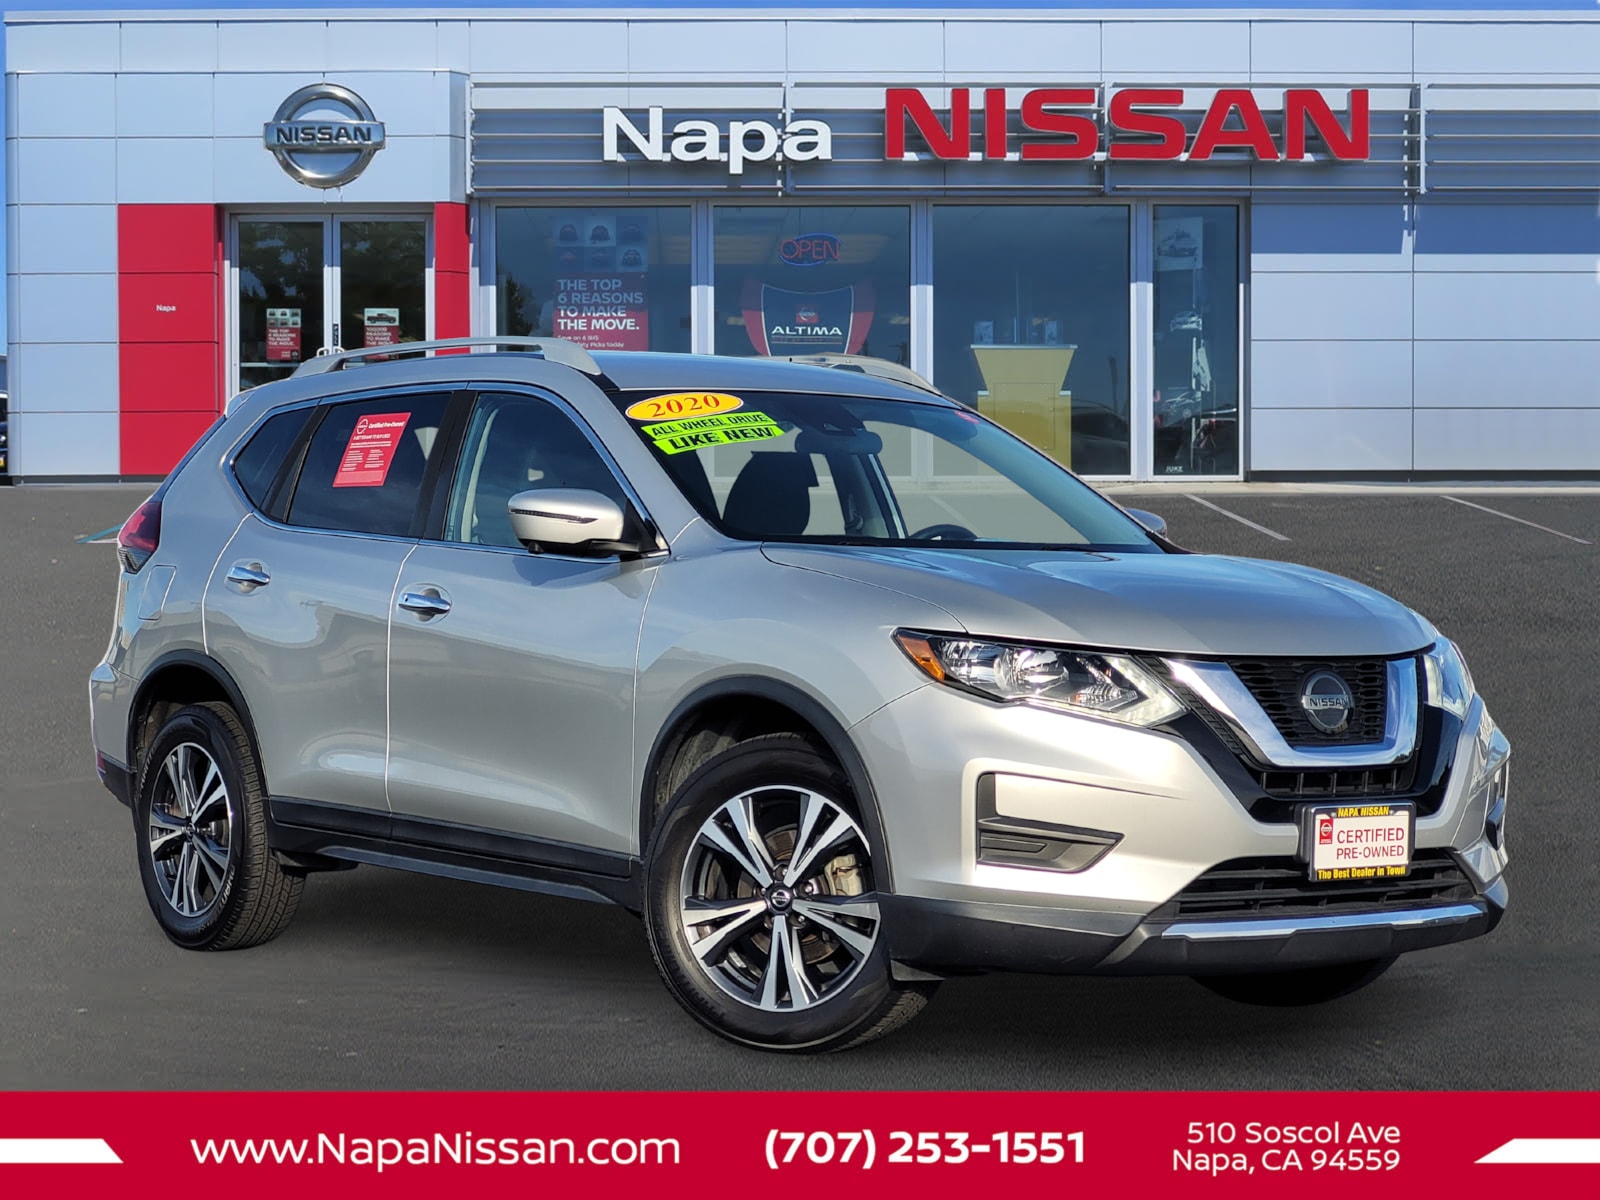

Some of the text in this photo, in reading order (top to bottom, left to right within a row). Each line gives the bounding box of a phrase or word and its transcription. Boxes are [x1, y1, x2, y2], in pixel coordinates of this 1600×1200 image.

[275, 125, 373, 144] NISSAN
[603, 88, 1370, 175] Napa NISSAN
[780, 240, 841, 260] OPEN
[557, 279, 621, 290] THE TOP
[558, 292, 643, 304] 6 REASONS
[156, 304, 176, 312] Napa
[557, 305, 626, 317] TO MAKE
[557, 318, 640, 330] THE MOVE.
[771, 326, 843, 336] ALTIMA
[647, 394, 720, 417] 2020
[652, 414, 767, 436] ALL WHEEL DRIVE
[669, 427, 773, 449] LIKE NEW
[1165, 465, 1183, 473] JUKE
[1309, 697, 1349, 707] NISSAN
[1337, 806, 1390, 818] NAPA NISSAN
[1336, 827, 1405, 844] CERTIFIED
[1336, 845, 1405, 860] PRE-OWNED
[1318, 865, 1406, 880] The Best Dealer in Town
